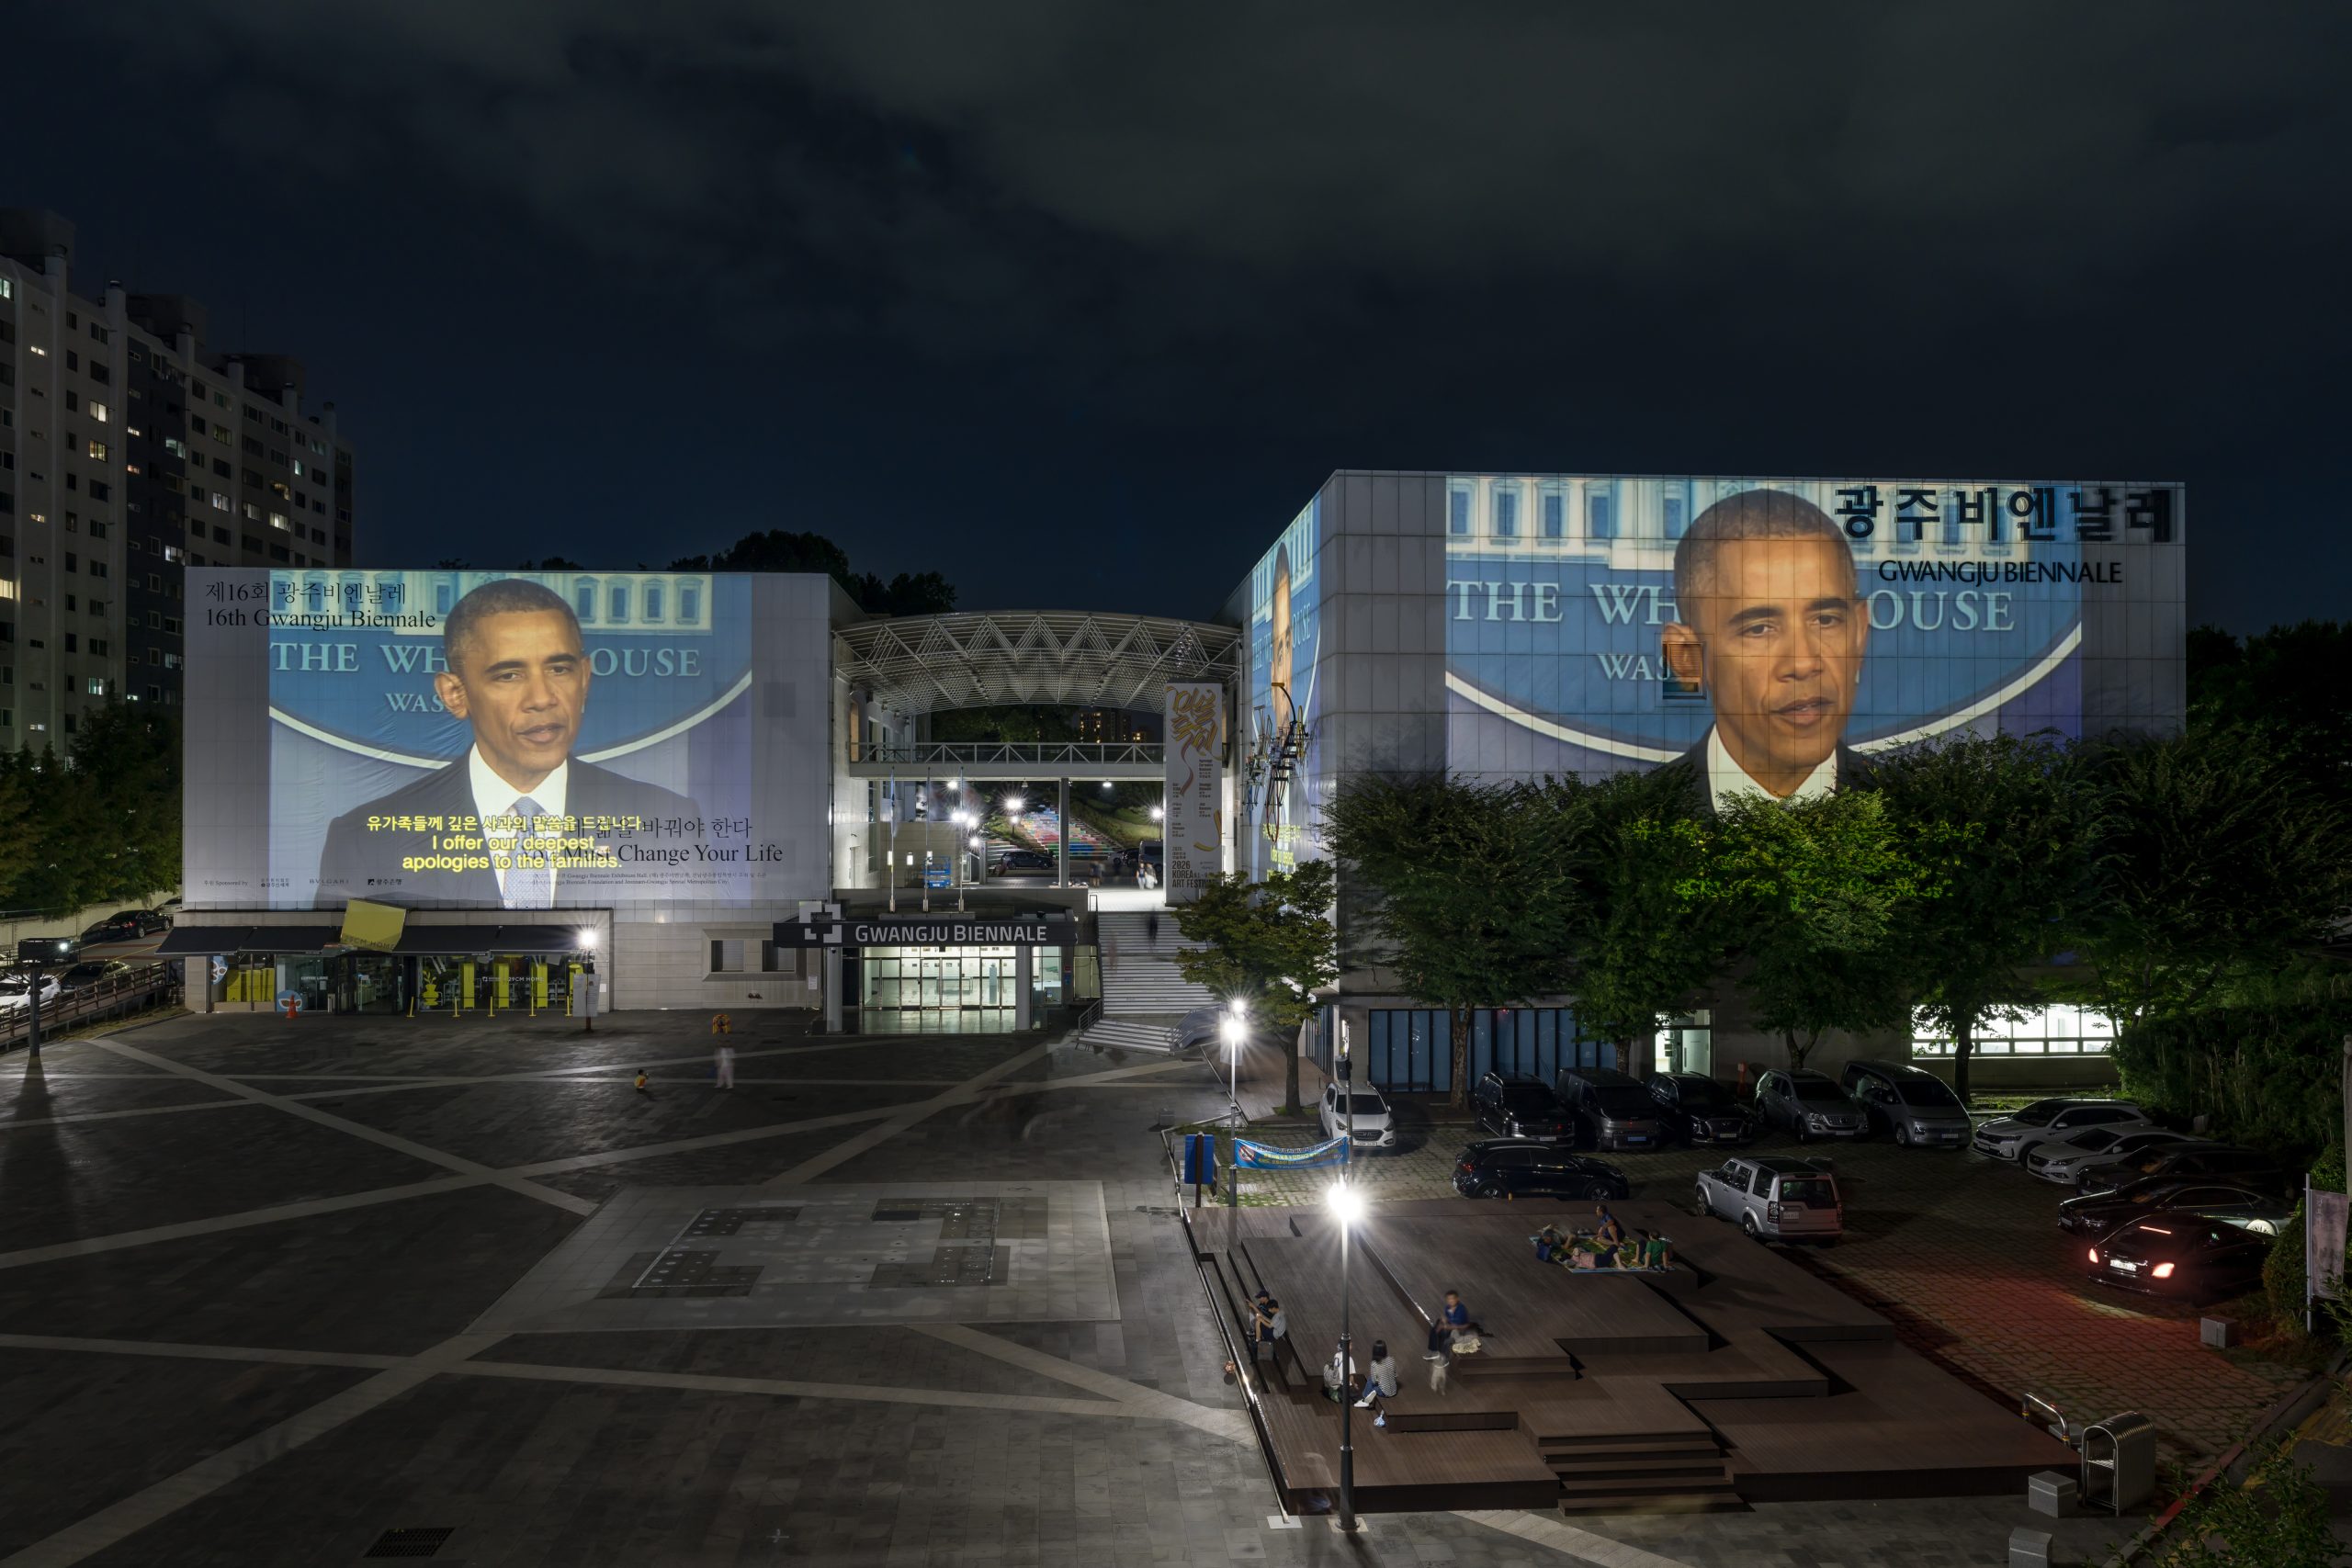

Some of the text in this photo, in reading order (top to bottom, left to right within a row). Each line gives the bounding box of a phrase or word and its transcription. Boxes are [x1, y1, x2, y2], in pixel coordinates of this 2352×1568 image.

[1835, 485, 2173, 544] 광주비엔날레
[1878, 559, 2122, 587] GWANGJU BIENNALE
[205, 581, 406, 605] 제16회 광주비엔날레
[1446, 580, 1564, 623] THE
[1865, 590, 2015, 632] OUSE
[206, 608, 436, 632] 16th Gwangju Biennale
[269, 642, 360, 672] THE
[589, 648, 702, 677] OUSE
[367, 815, 443, 832] 유가족들께
[447, 816, 478, 832] 깊은
[483, 816, 527, 832] 사과의
[533, 816, 577, 832] 말씀을
[582, 816, 645, 832] 드립니다.
[644, 817, 705, 840] 바꿔야
[711, 817, 753, 840] 한다
[432, 835, 595, 853] I offer our deepest
[617, 843, 690, 866] Change
[694, 844, 739, 862] Your
[745, 843, 784, 862] Life
[402, 854, 622, 872] apologies to the families.
[1172, 860, 1191, 870] 2026
[1172, 870, 1193, 879] KOREA
[1172, 879, 1184, 888] ART
[855, 924, 1047, 942] GWANGJU BIENNALE
